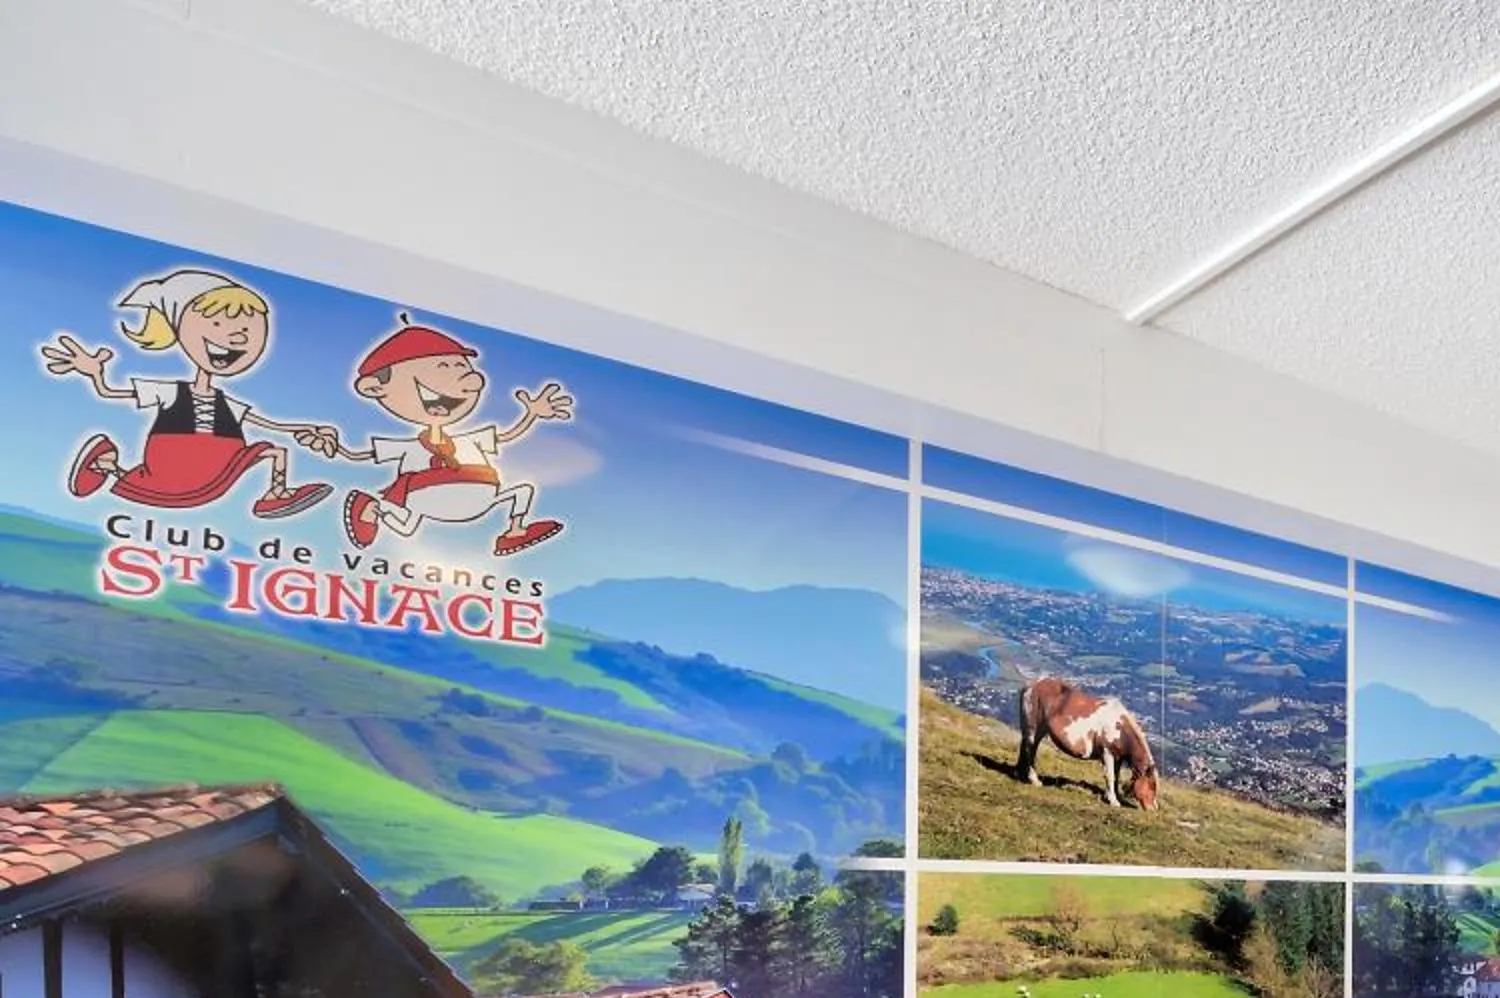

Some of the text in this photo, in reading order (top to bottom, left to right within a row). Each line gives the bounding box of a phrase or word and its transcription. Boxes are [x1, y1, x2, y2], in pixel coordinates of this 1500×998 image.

[106, 514, 543, 598] Club de vacances
[228, 559, 547, 646] IGNACE
